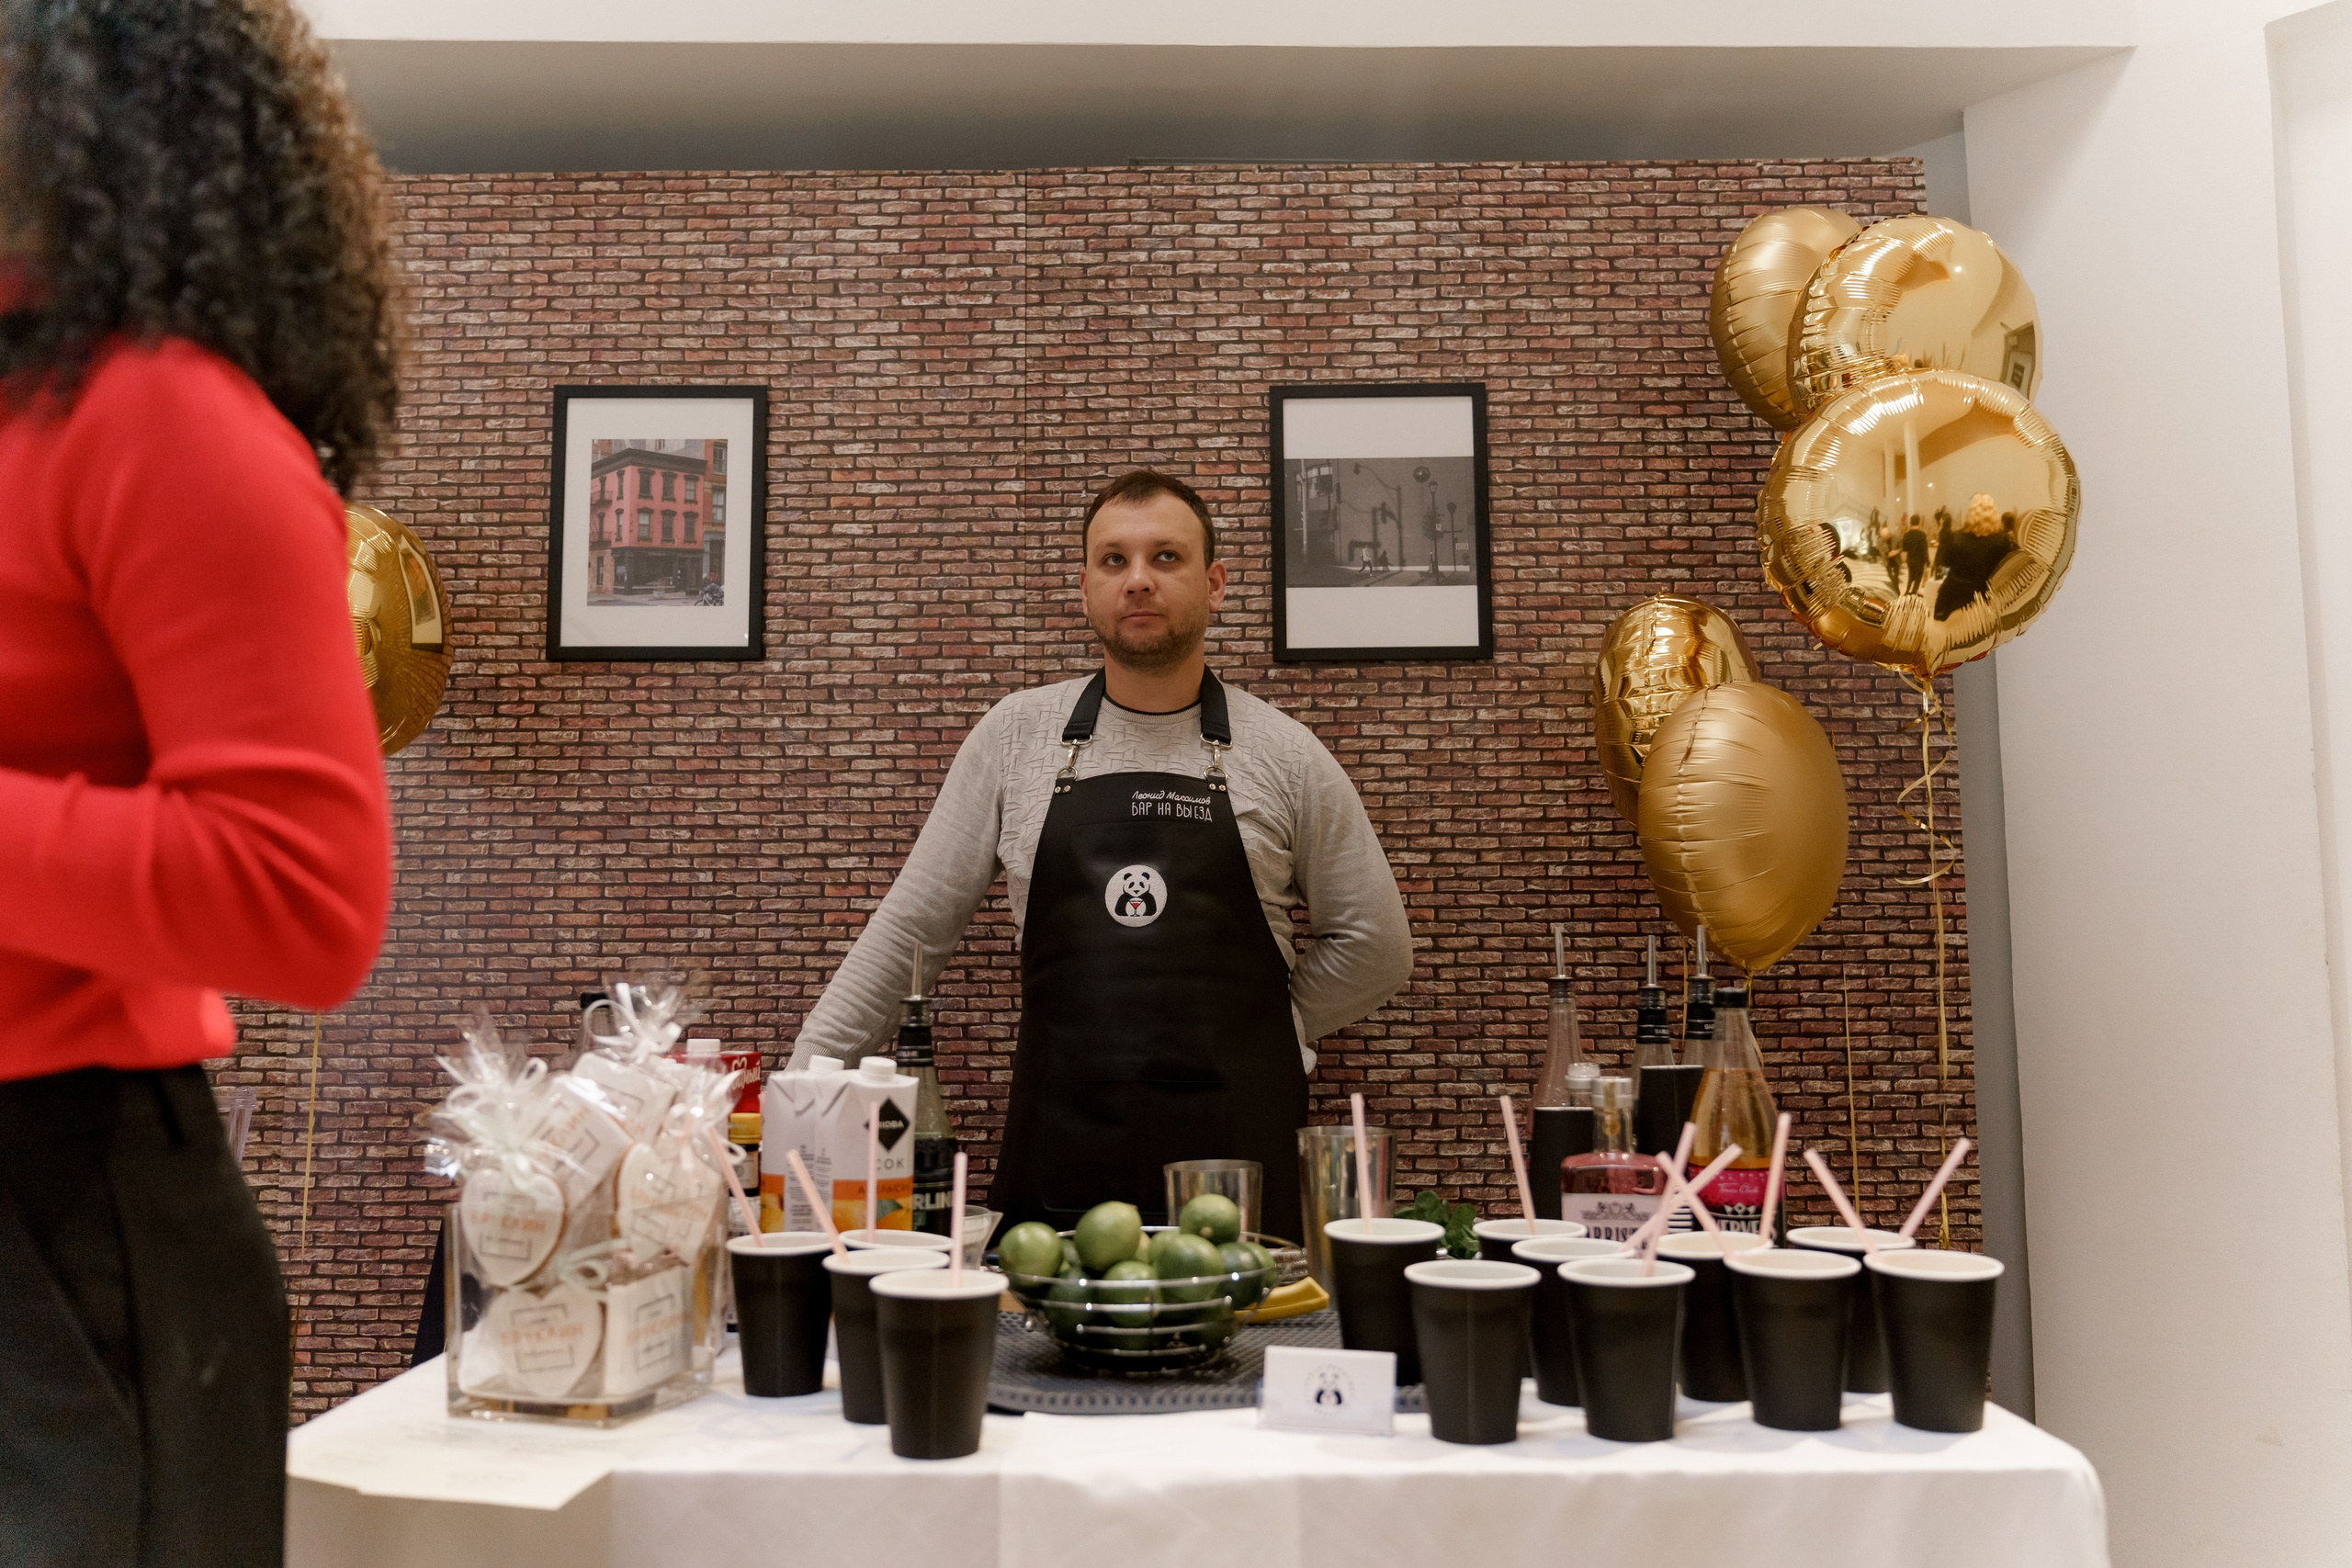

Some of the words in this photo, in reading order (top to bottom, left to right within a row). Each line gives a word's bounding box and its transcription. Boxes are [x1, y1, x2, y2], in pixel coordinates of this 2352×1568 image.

[1131, 801, 1153, 817] БАР
[1158, 802, 1171, 817] НА
[1176, 803, 1213, 823] ВЫЕЗД
